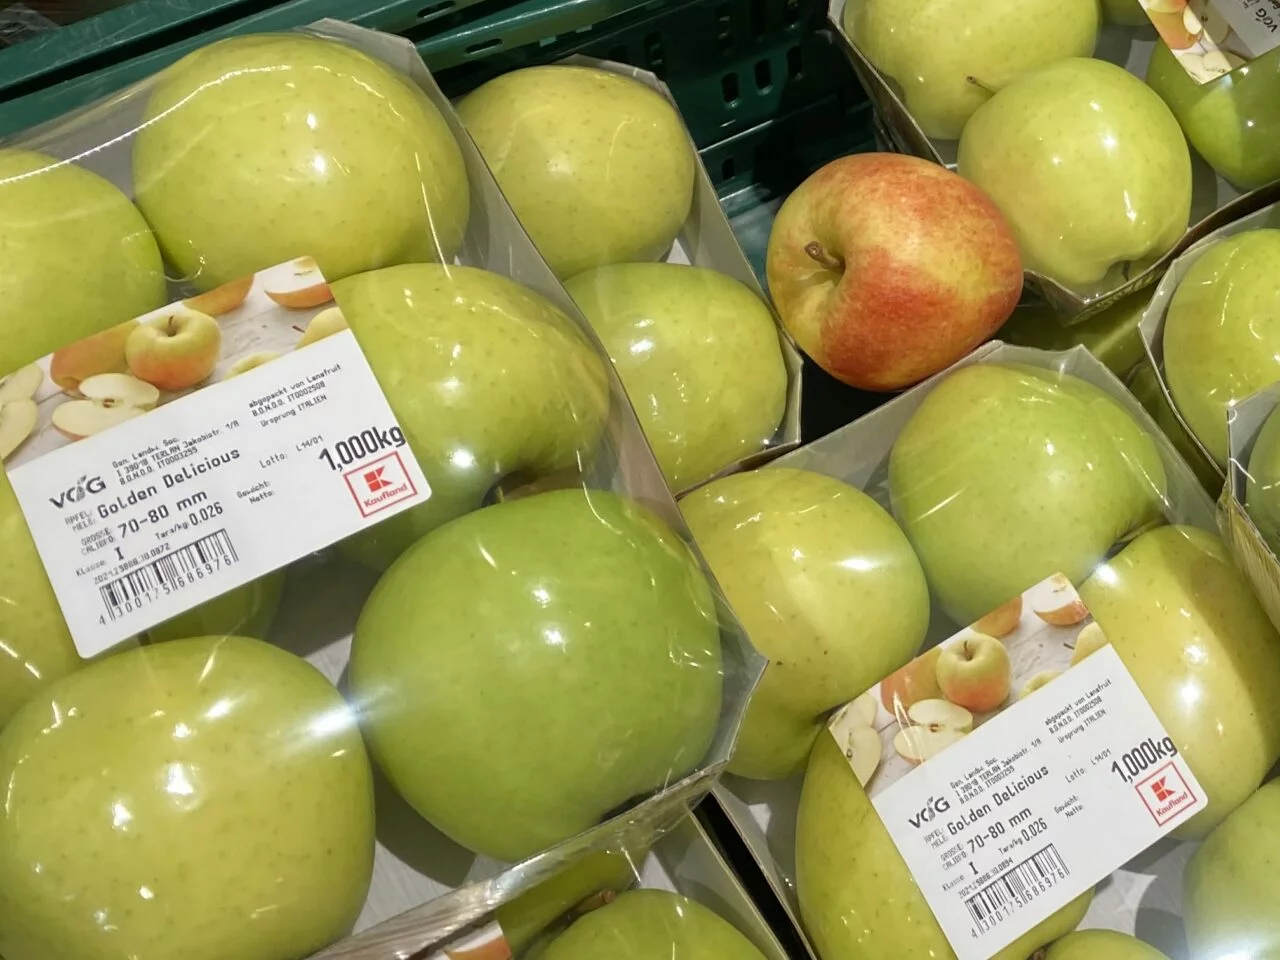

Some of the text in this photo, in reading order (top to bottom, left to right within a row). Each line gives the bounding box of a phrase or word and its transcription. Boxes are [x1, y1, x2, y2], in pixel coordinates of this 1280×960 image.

[151, 444, 180, 461] TERLAN
[319, 426, 405, 470] 1,000kg
[97, 449, 239, 518] Golden Delicious
[363, 483, 407, 507] Kaufland
[118, 491, 207, 537] 70-80 mm
[188, 501, 223, 525] 0.026
[1111, 737, 1177, 782] 1,000kg
[947, 766, 1048, 835] Golden Delicious
[1156, 791, 1188, 816] Kaufland
[967, 807, 1032, 853] 70-80 mm
[1020, 817, 1047, 841] 0.026
